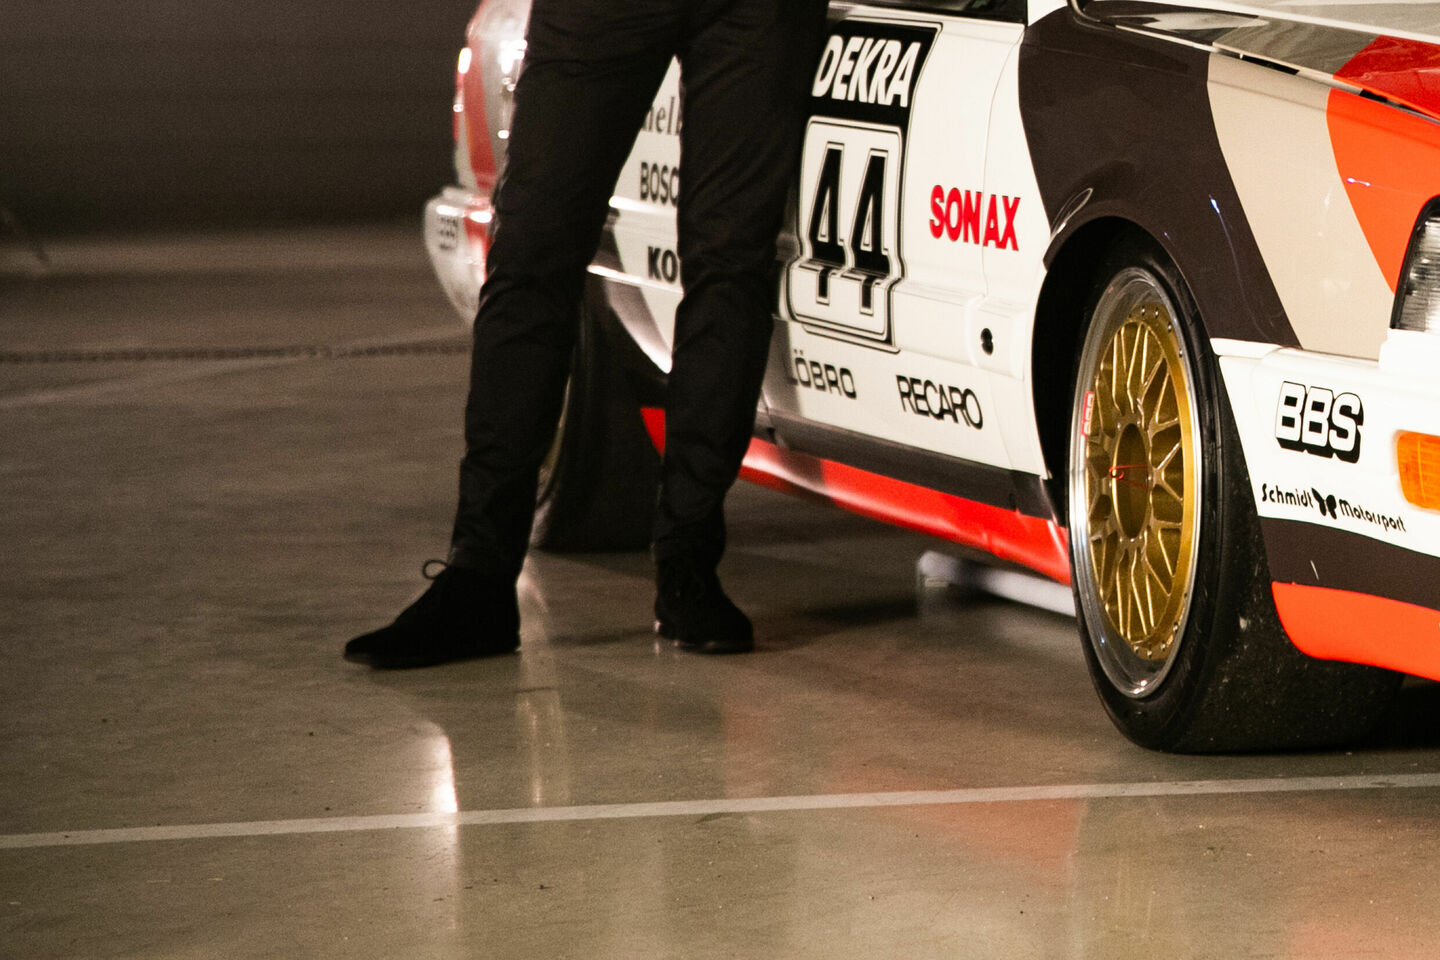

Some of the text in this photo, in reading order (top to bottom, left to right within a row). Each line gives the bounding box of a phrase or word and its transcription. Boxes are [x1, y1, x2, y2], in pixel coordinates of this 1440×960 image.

[812, 36, 921, 107] DEKRA
[639, 161, 680, 207] BOSC
[928, 184, 1021, 251] SONAX
[806, 141, 896, 316] 44
[896, 374, 984, 430] RECARO
[1275, 381, 1364, 463] BBS
[1261, 482, 1406, 532] Schmidt Motorsport
